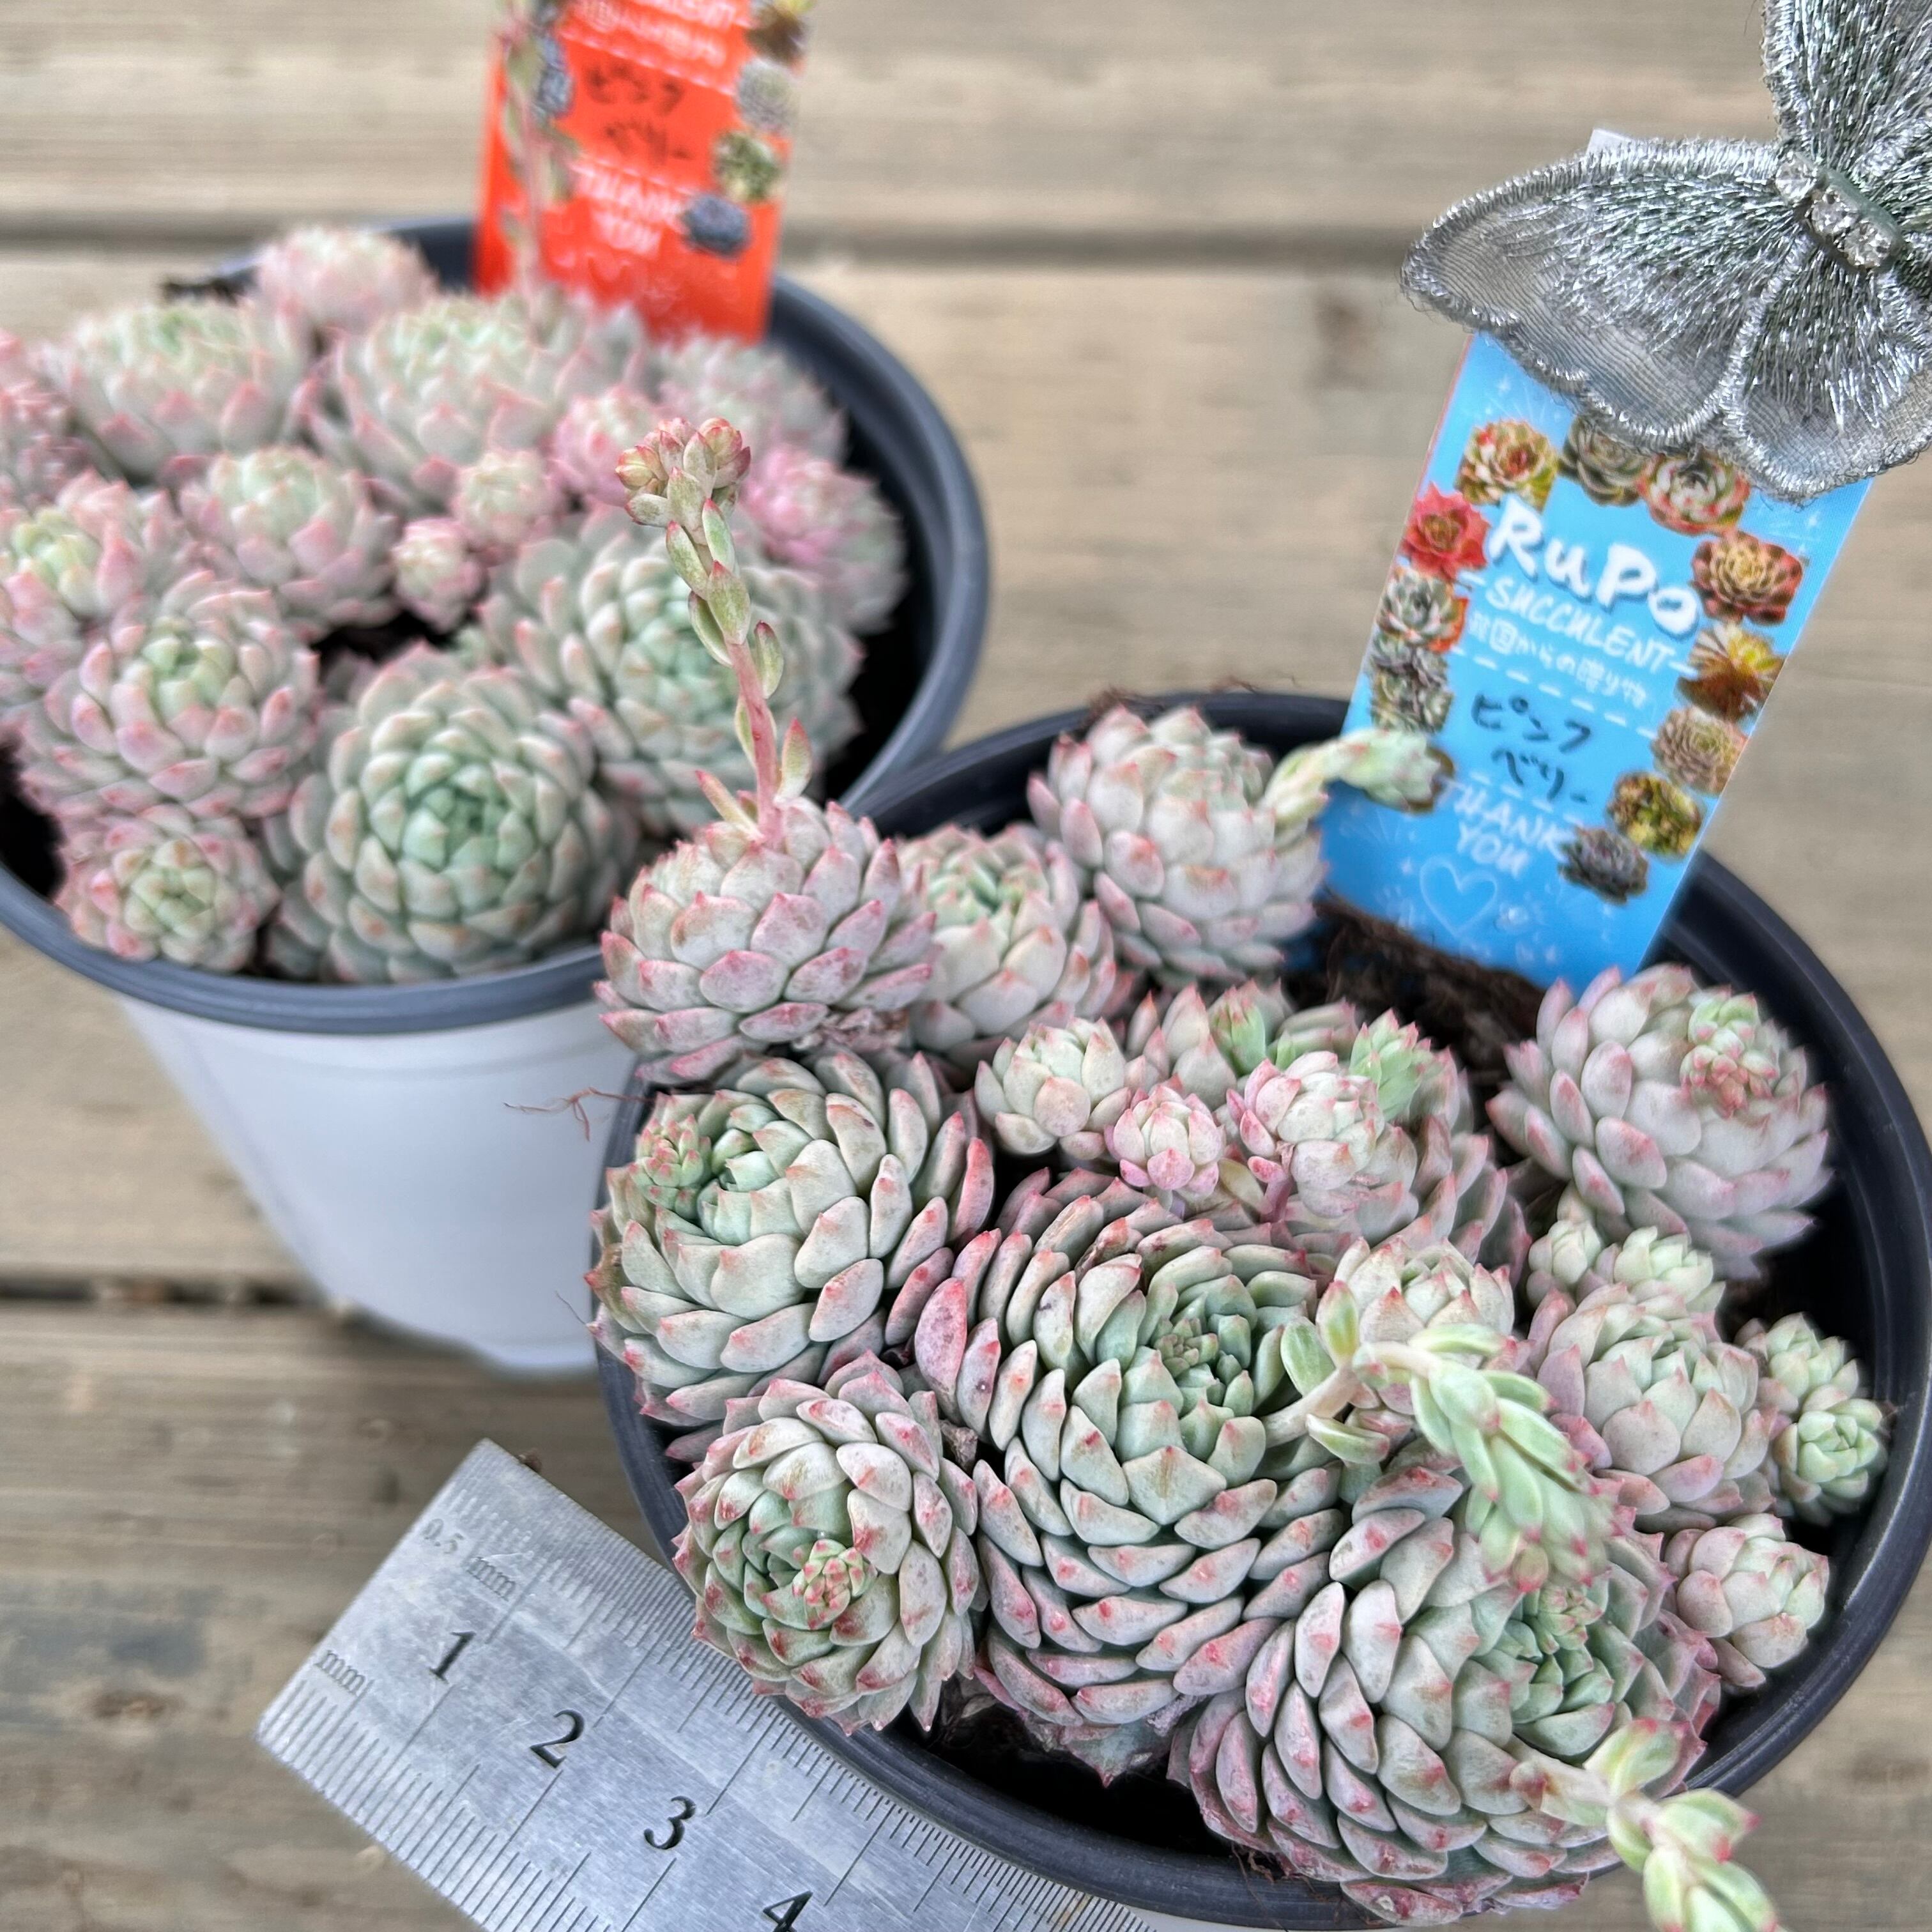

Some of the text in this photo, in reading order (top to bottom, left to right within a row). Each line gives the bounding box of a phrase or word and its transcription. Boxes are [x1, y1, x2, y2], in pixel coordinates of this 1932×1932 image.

[1485, 576, 1677, 674] SUCCULENT
[1457, 820, 1530, 880] YOU
[421, 1517, 518, 1602] 0.5 mm
[315, 1649, 368, 1696] mm
[429, 1630, 477, 1683] 1
[530, 1708, 586, 1769] 2
[643, 1795, 696, 1850] 3
[762, 1890, 814, 1932] 4
